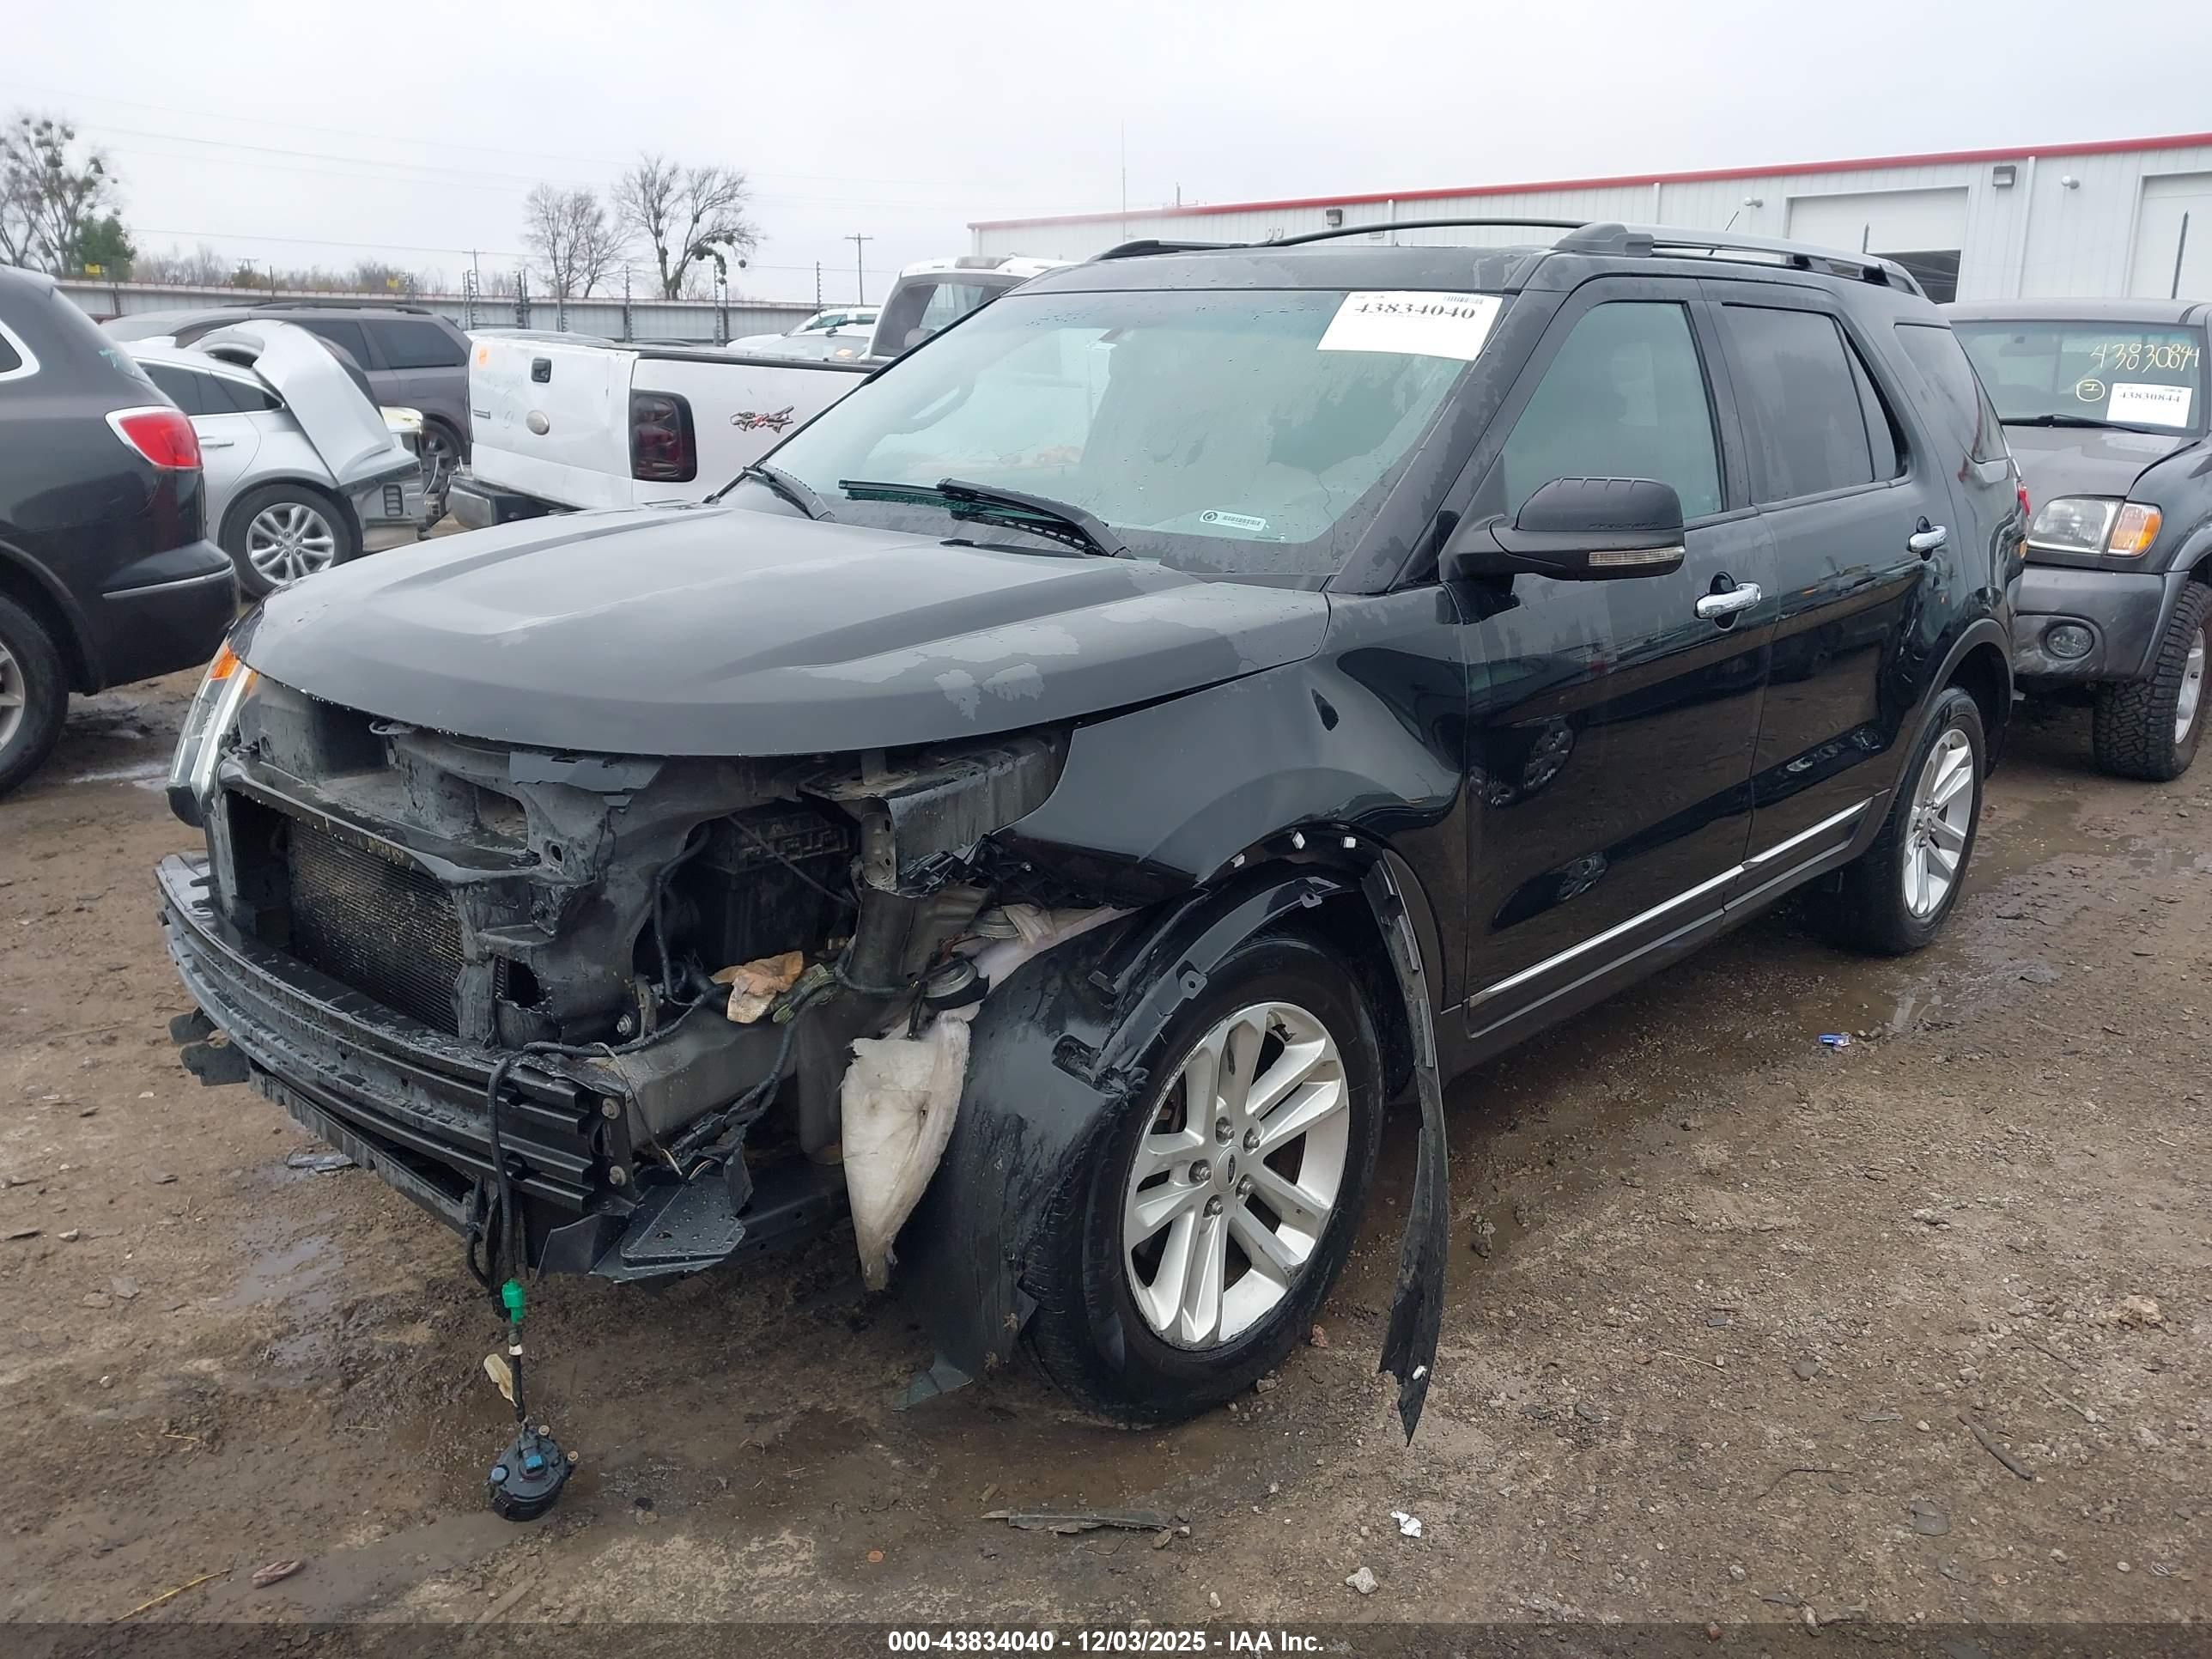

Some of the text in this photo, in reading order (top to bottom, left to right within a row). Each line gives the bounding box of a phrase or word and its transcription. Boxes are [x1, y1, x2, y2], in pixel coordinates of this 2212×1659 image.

[1354, 303, 1476, 319] 43834040
[2090, 343, 2201, 373] 43830844
[2120, 392, 2180, 403] 43830844
